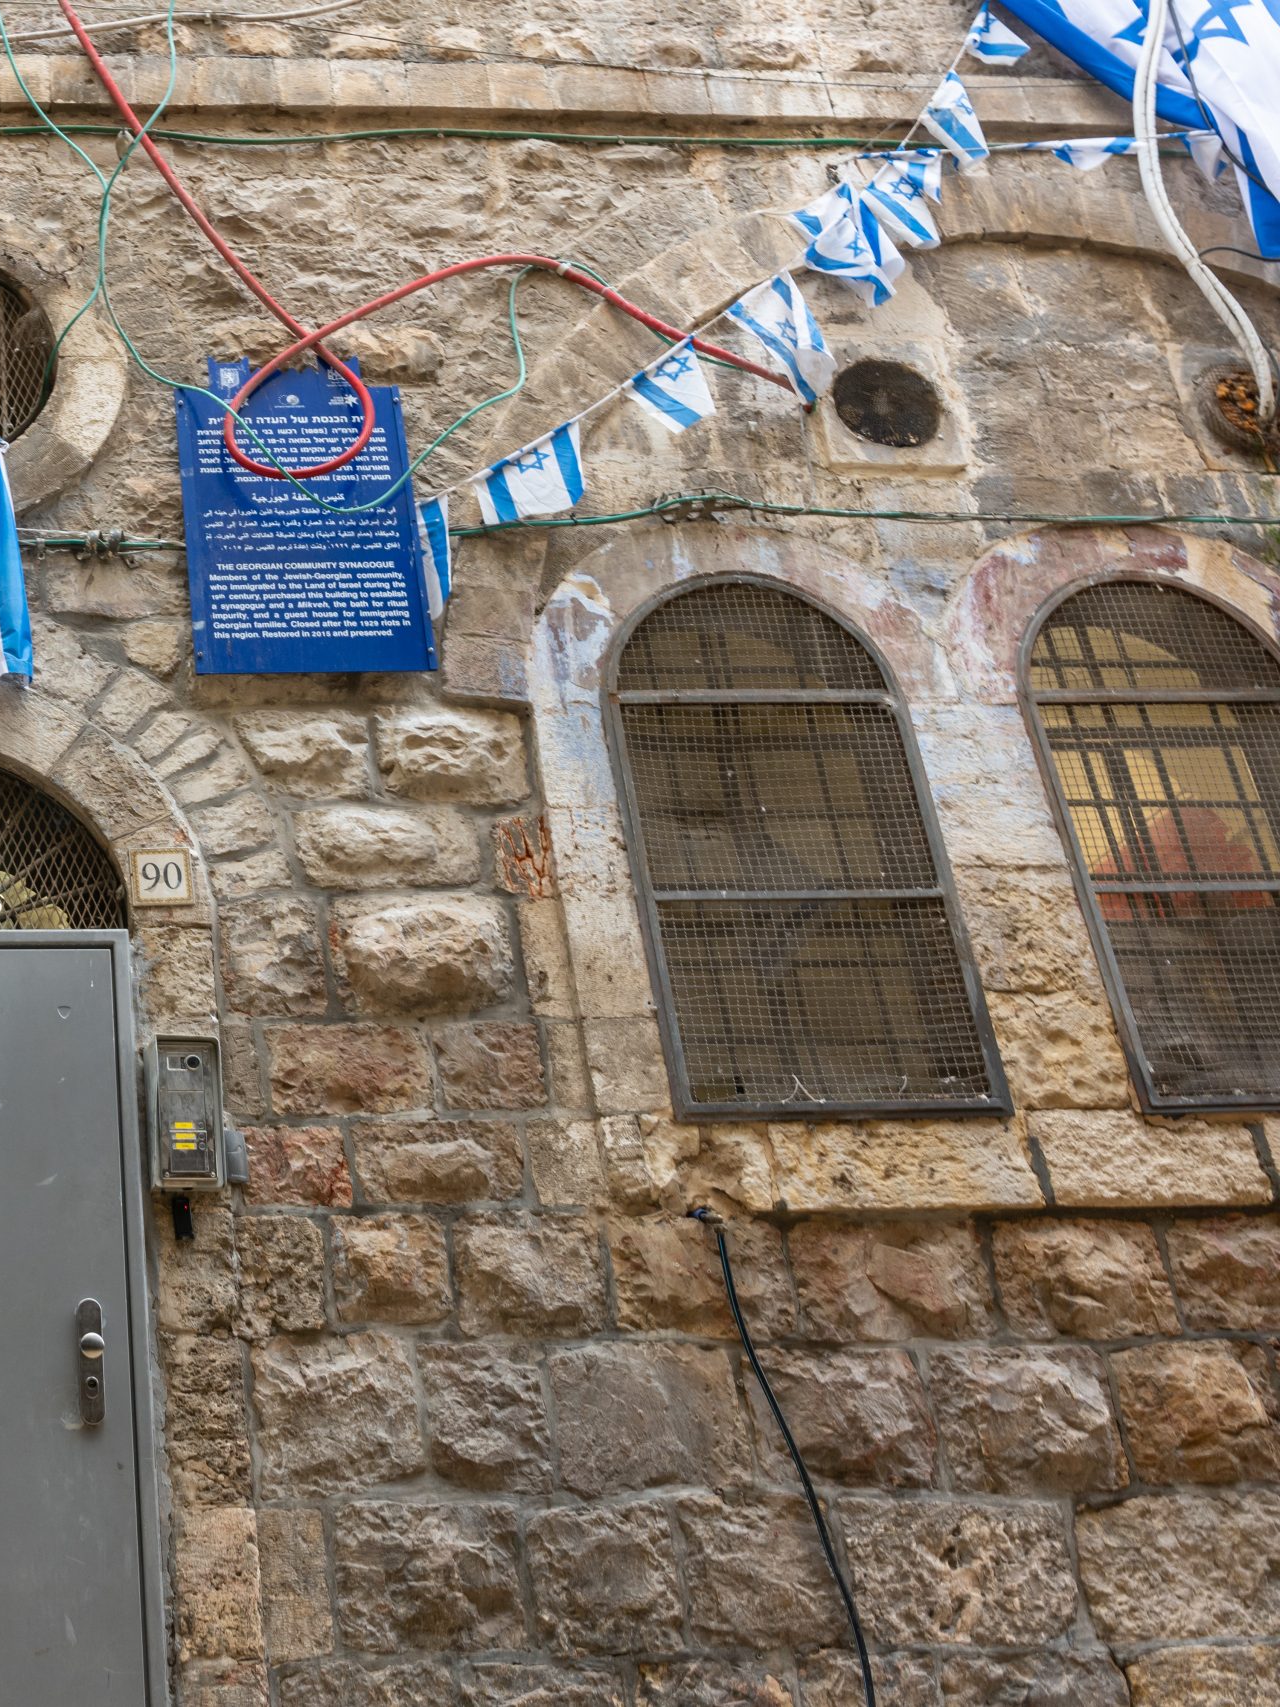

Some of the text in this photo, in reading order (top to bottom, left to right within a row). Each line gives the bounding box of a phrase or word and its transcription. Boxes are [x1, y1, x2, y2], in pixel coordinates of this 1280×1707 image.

[360, 591, 368, 600] to
[370, 589, 407, 597] establish
[213, 622, 252, 630] Georgian
[381, 618, 400, 626] riots
[142, 862, 182, 890] 90
